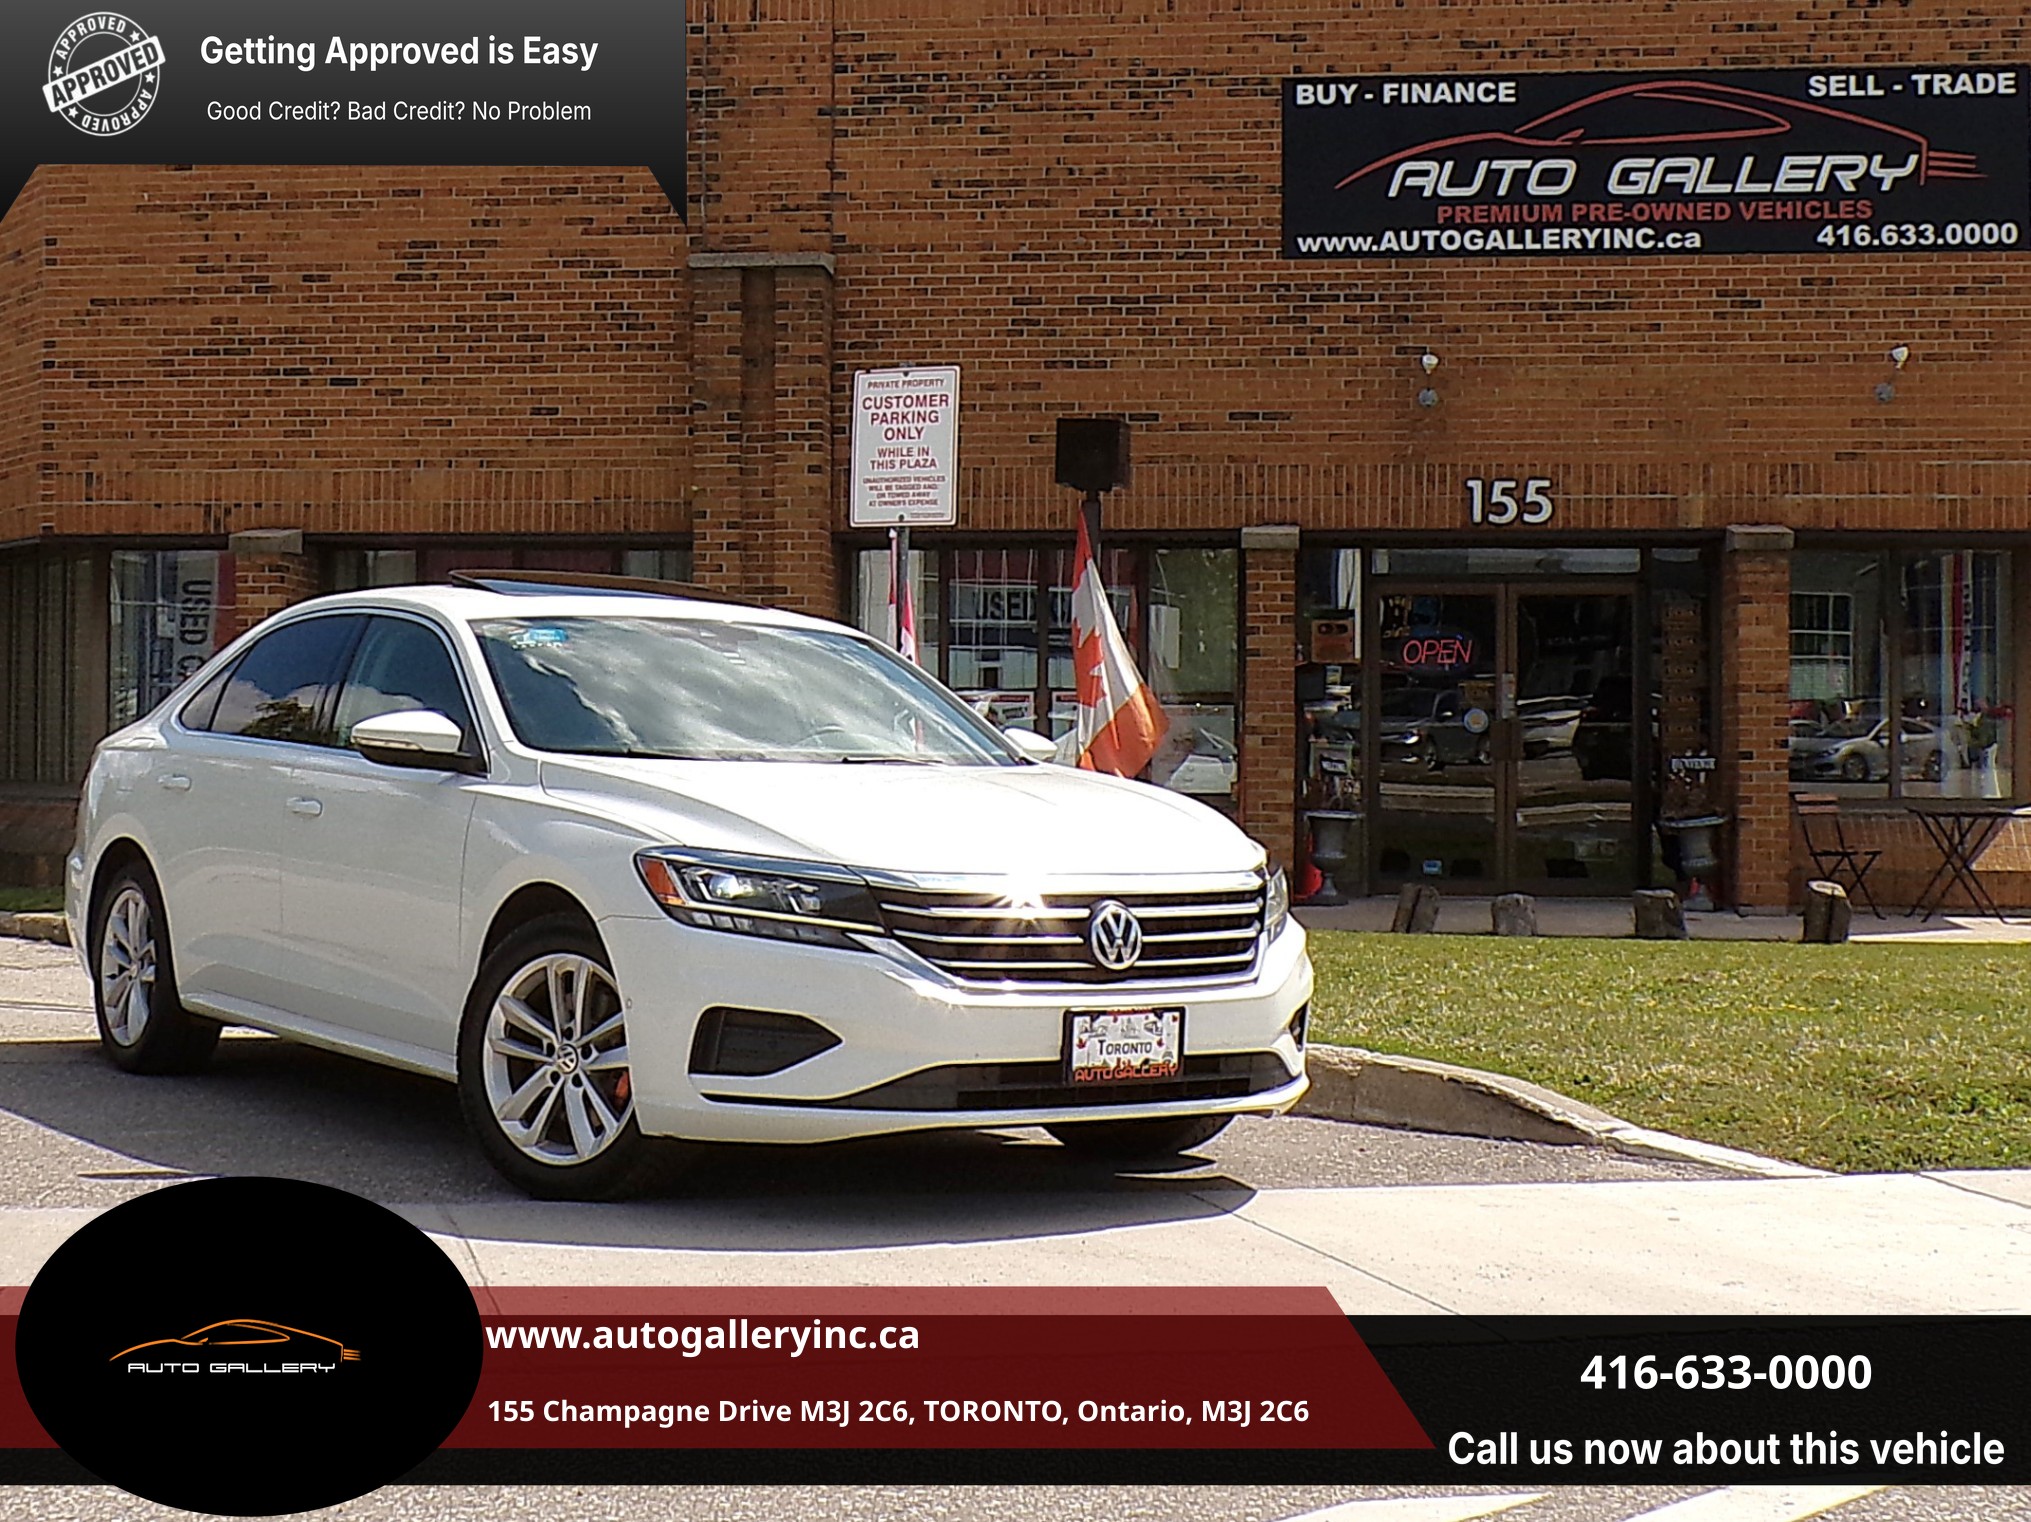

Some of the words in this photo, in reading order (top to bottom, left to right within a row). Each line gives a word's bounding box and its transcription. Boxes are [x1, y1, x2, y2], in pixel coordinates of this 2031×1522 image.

[1296, 83, 1358, 105] BUY
[1383, 81, 1516, 104] FINANCE
[1808, 74, 1885, 97] SELL
[1911, 72, 2016, 96] TRADE
[1387, 158, 1577, 198] AUTO
[1607, 154, 1918, 195] GALLERY
[1436, 203, 1563, 224] PREMIUM
[1570, 201, 1732, 223] PRE-OWNED
[1739, 199, 1874, 221] VEHICLES
[1297, 227, 1701, 253] www.AUTOGALLERYINC.ca
[1816, 222, 2018, 247] 416.633.0000
[867, 380, 899, 389] PRIVATE
[902, 378, 945, 387] PROPERTY
[862, 394, 949, 410] CUSTOMER
[870, 410, 939, 425] PARKING
[884, 426, 924, 441] ONLY
[870, 460, 896, 470] THIS
[900, 458, 937, 469] PLAZA
[877, 447, 914, 457] WHILE
[917, 446, 930, 456] IN
[1466, 480, 1552, 523] 155
[179, 580, 212, 645] USED
[1403, 639, 1472, 664] OPEN
